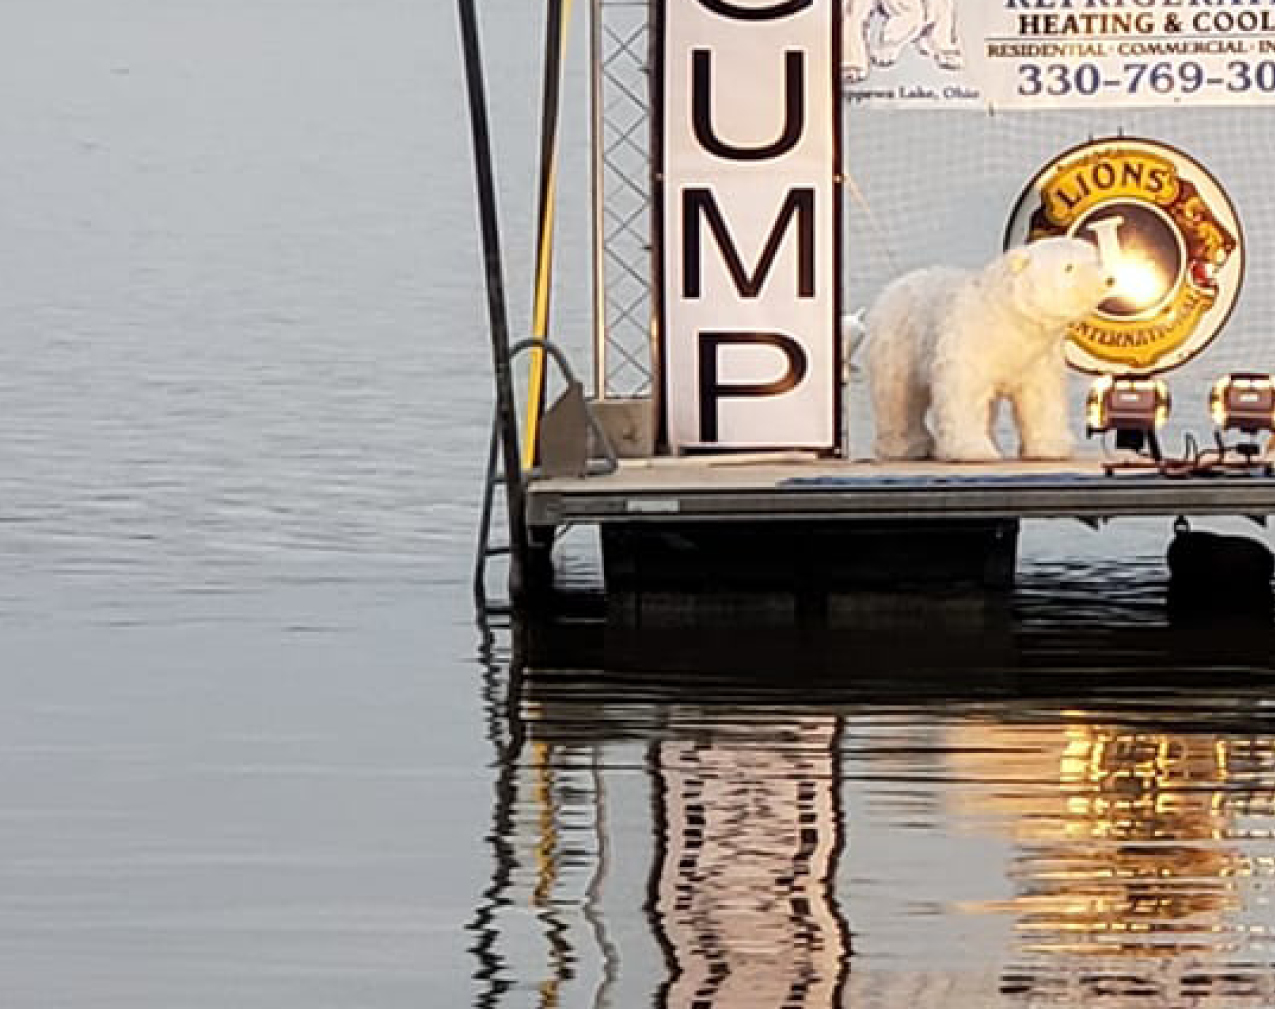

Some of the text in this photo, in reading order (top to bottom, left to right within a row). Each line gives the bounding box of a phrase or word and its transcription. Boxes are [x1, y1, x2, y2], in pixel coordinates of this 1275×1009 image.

[1018, 12, 1154, 36] HEATING
[1163, 11, 1183, 33] &
[985, 42, 1107, 59] RESIDENTIAL
[1116, 41, 1248, 56] COMMERCIAL
[1056, 161, 1165, 209] LIONS
